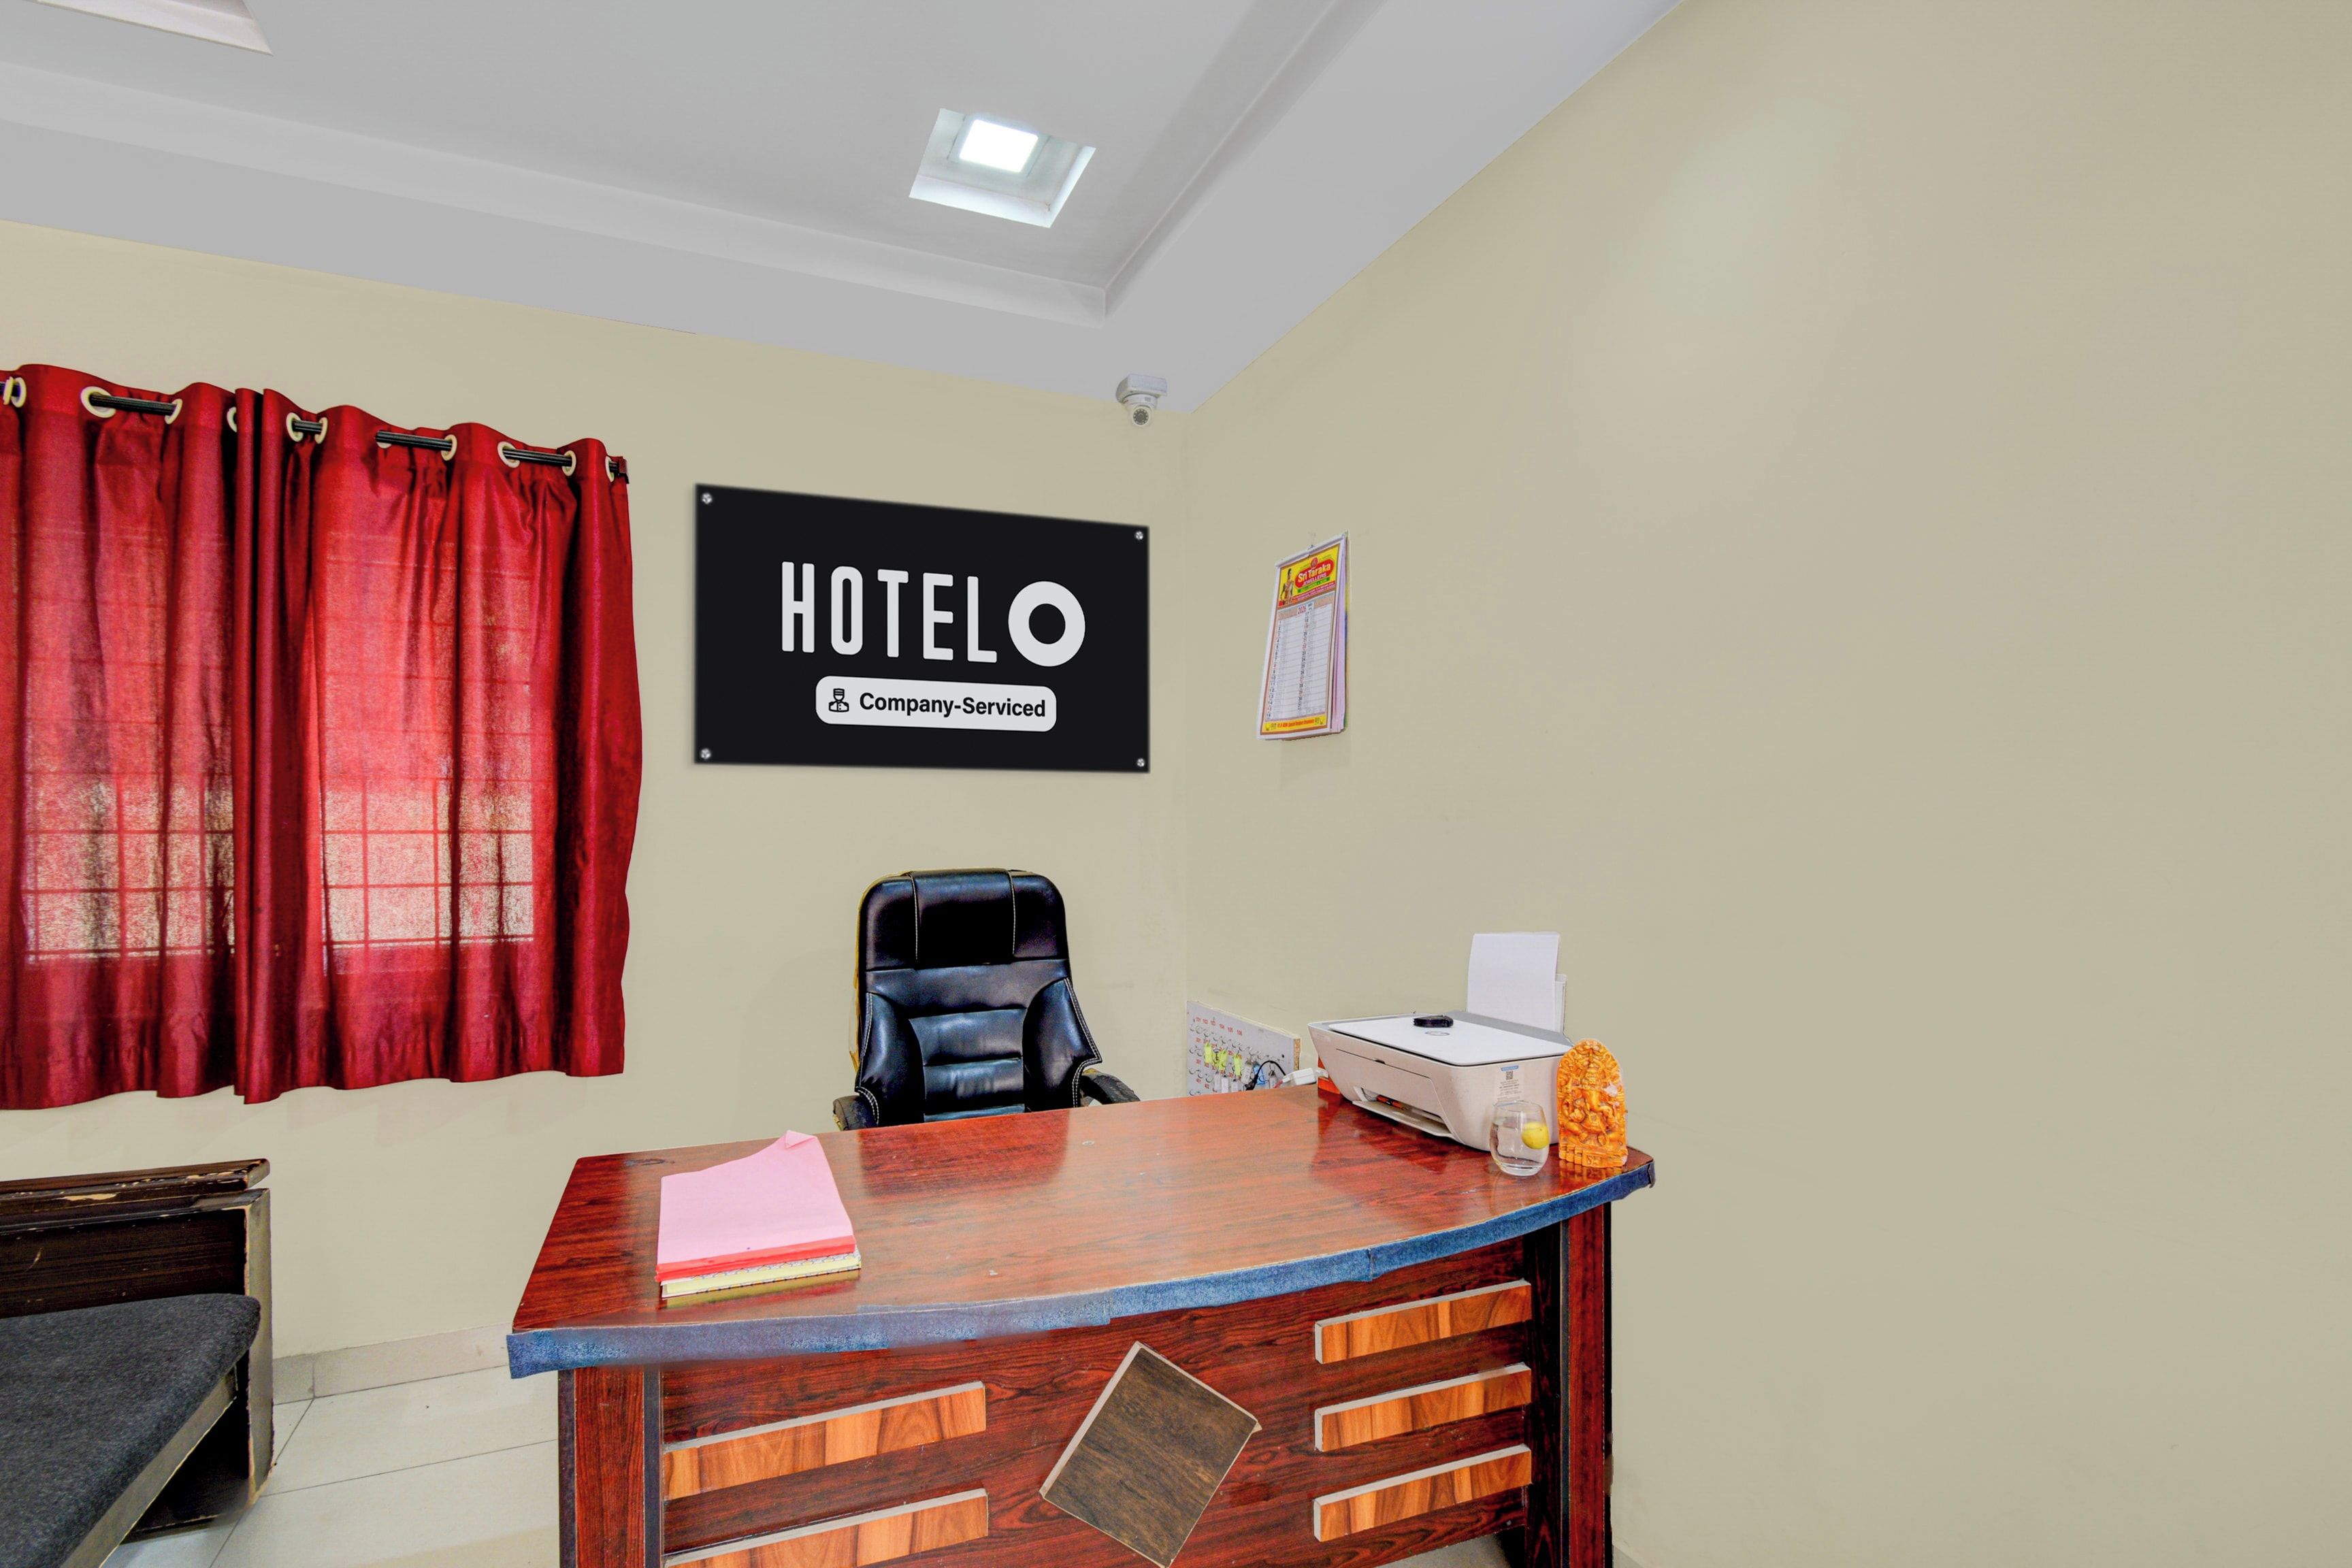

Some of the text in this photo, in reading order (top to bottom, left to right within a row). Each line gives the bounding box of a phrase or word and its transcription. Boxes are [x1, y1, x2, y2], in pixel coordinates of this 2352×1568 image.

[1298, 571, 1307, 583] Sri
[1308, 564, 1331, 578] Taraka
[781, 561, 1085, 667] HOTEL O
[859, 692, 1046, 719] Company-Serviced
